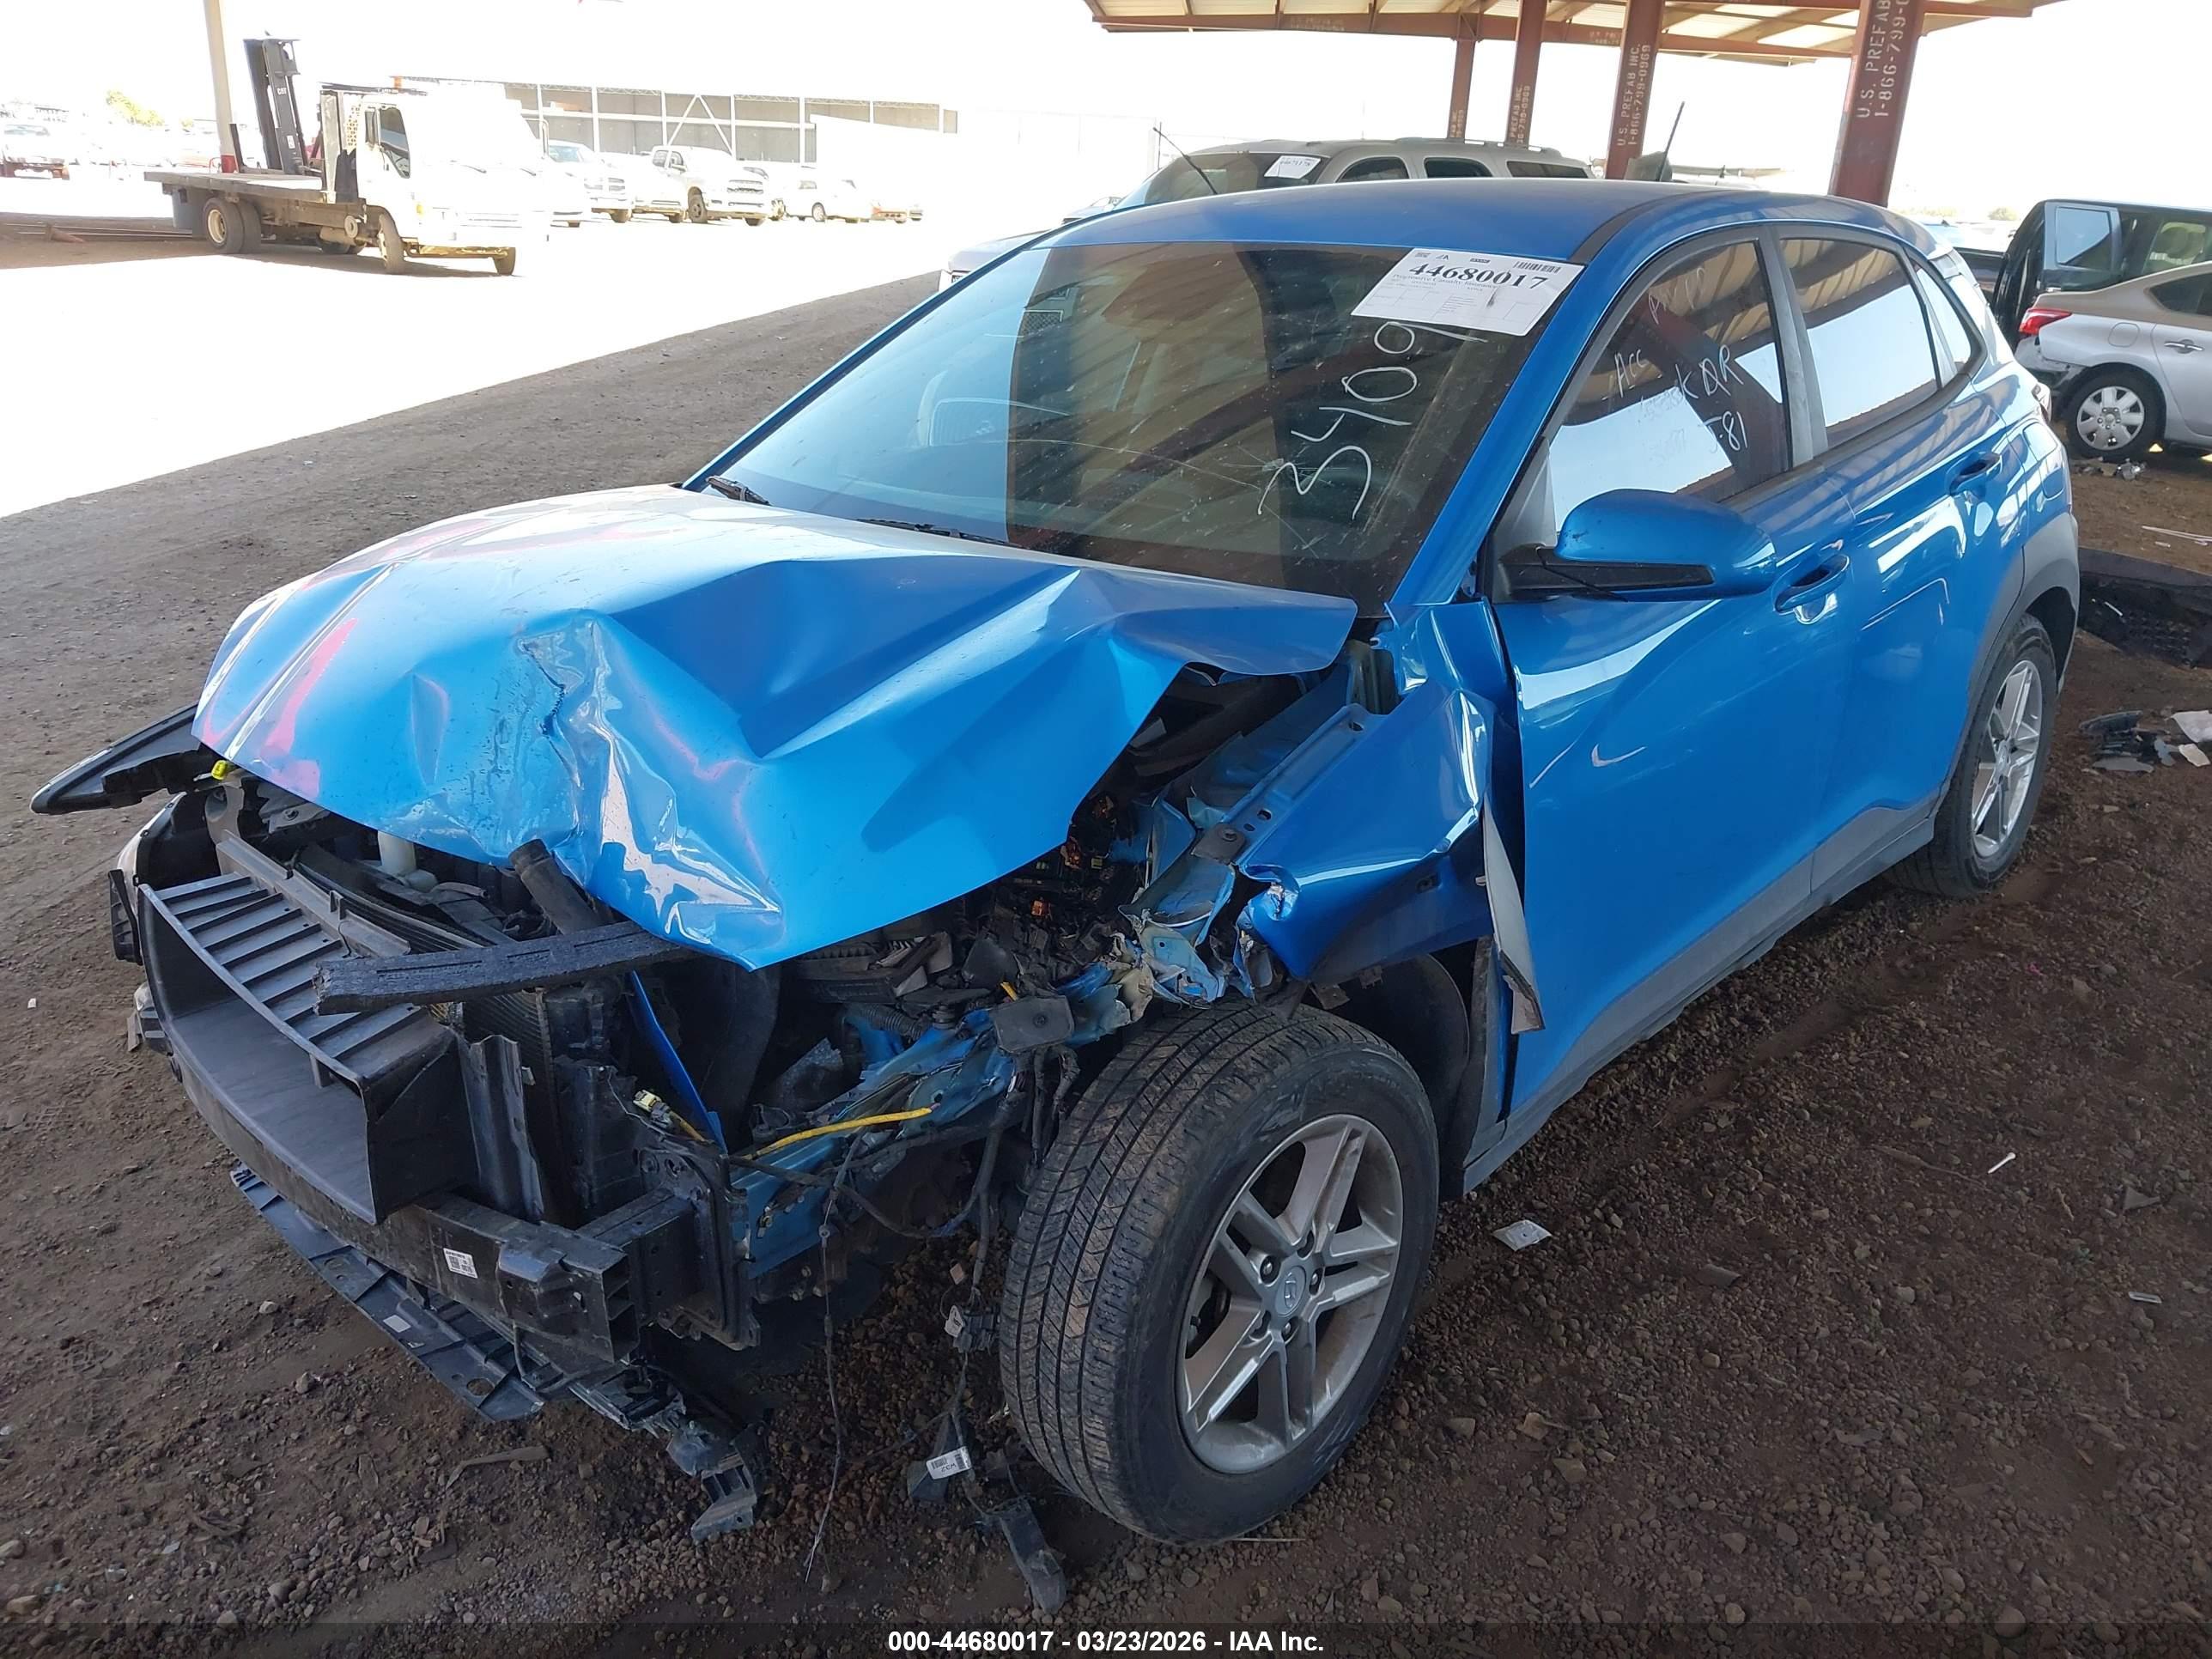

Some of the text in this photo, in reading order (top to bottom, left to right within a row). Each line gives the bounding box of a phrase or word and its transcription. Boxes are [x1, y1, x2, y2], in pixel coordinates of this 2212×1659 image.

[1856, 0, 1892, 118] U.S. PREFAB
[1621, 72, 1637, 118] PREFAB
[1409, 263, 1549, 289] 44680017
